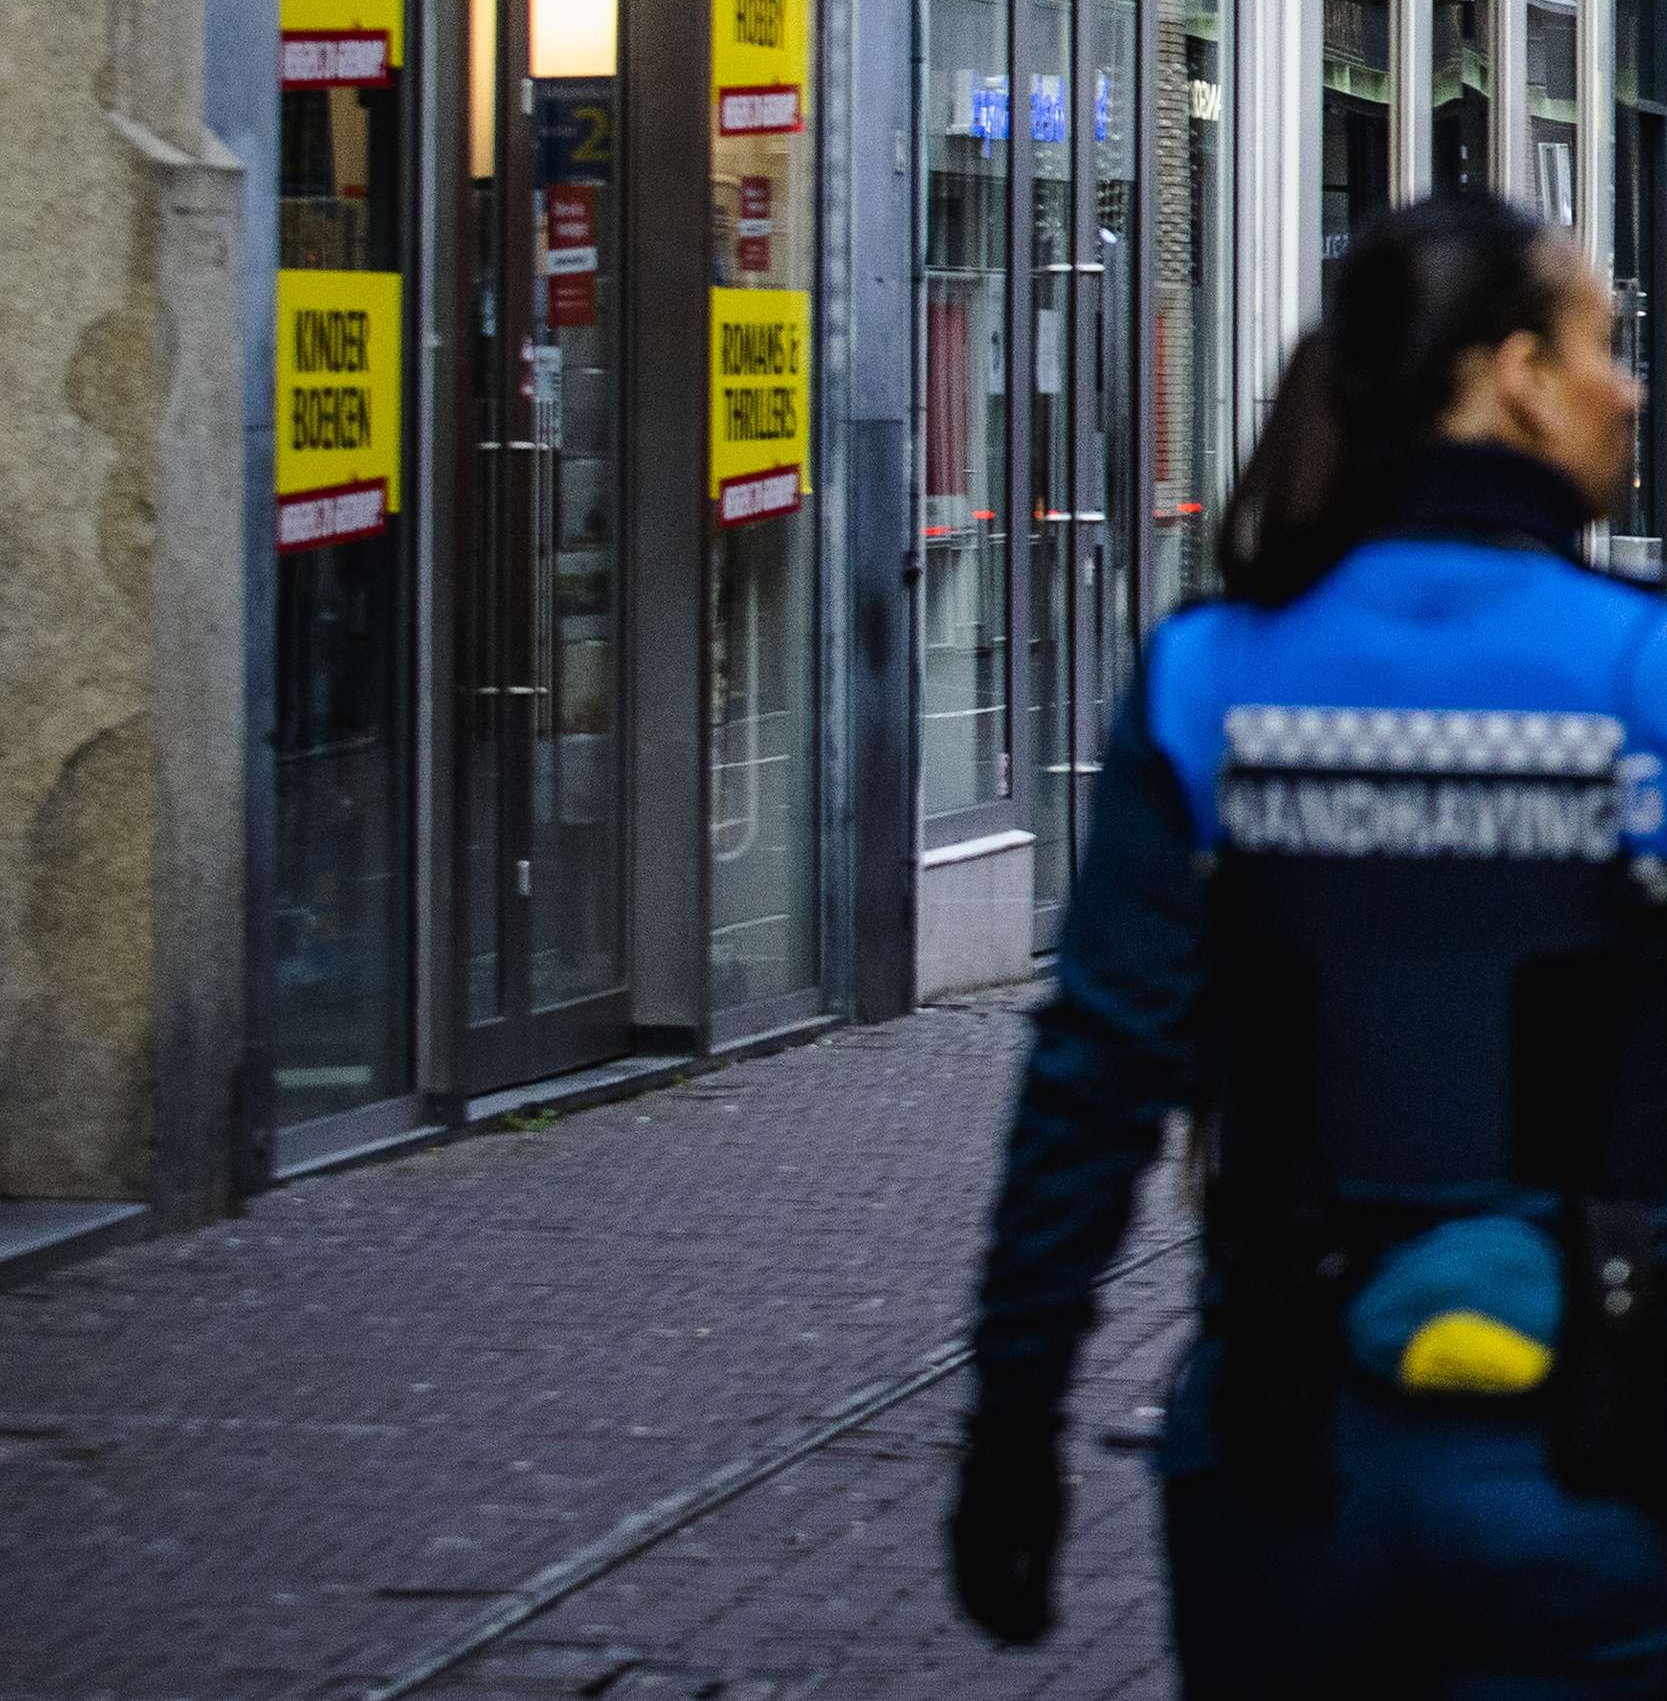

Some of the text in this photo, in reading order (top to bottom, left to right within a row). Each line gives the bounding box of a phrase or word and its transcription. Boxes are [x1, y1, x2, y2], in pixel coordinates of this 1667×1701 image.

[293, 308, 371, 374] KINDER
[291, 384, 372, 451] BOEKEN
[723, 387, 797, 441] THRILLERS
